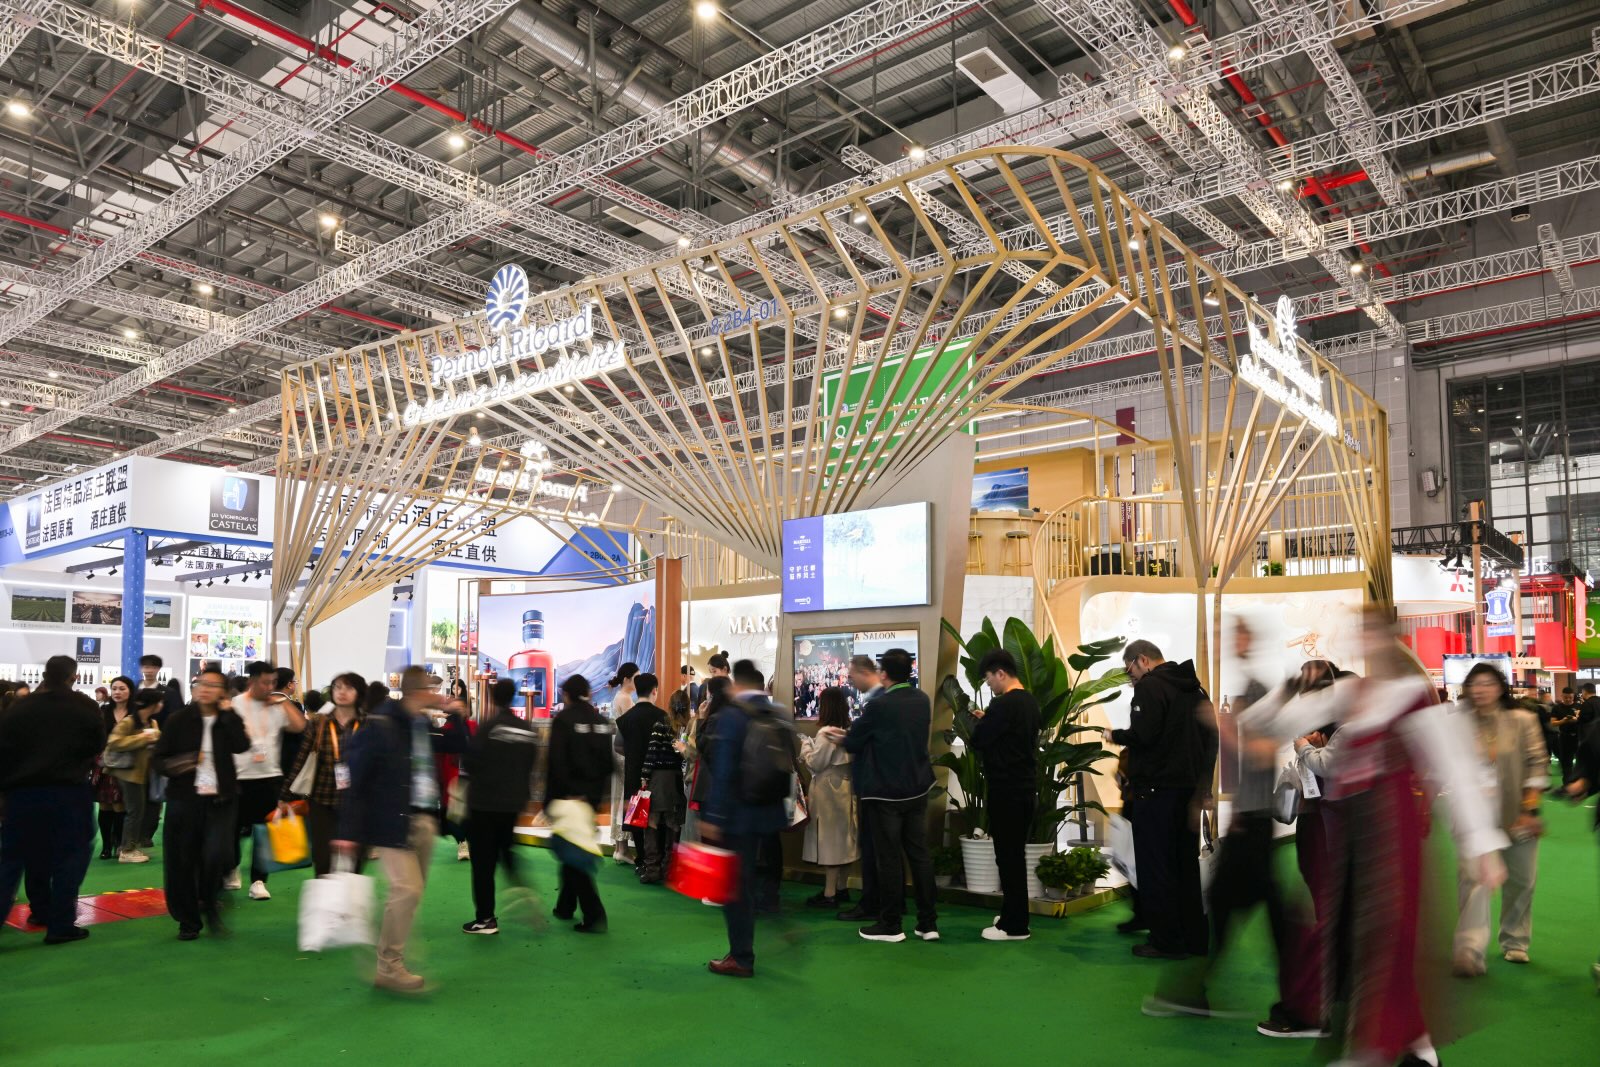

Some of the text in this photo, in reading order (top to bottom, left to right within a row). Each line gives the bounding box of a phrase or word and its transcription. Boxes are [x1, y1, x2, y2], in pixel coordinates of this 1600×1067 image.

[711, 299, 777, 335] 8.2B4-01
[431, 304, 591, 386] Pernod Ricard
[43, 464, 129, 515] 法国精品酒庄联盟
[42, 517, 74, 543] 法国原瓶
[90, 501, 127, 530] 酒庄直供
[210, 519, 257, 532] CASTELAS
